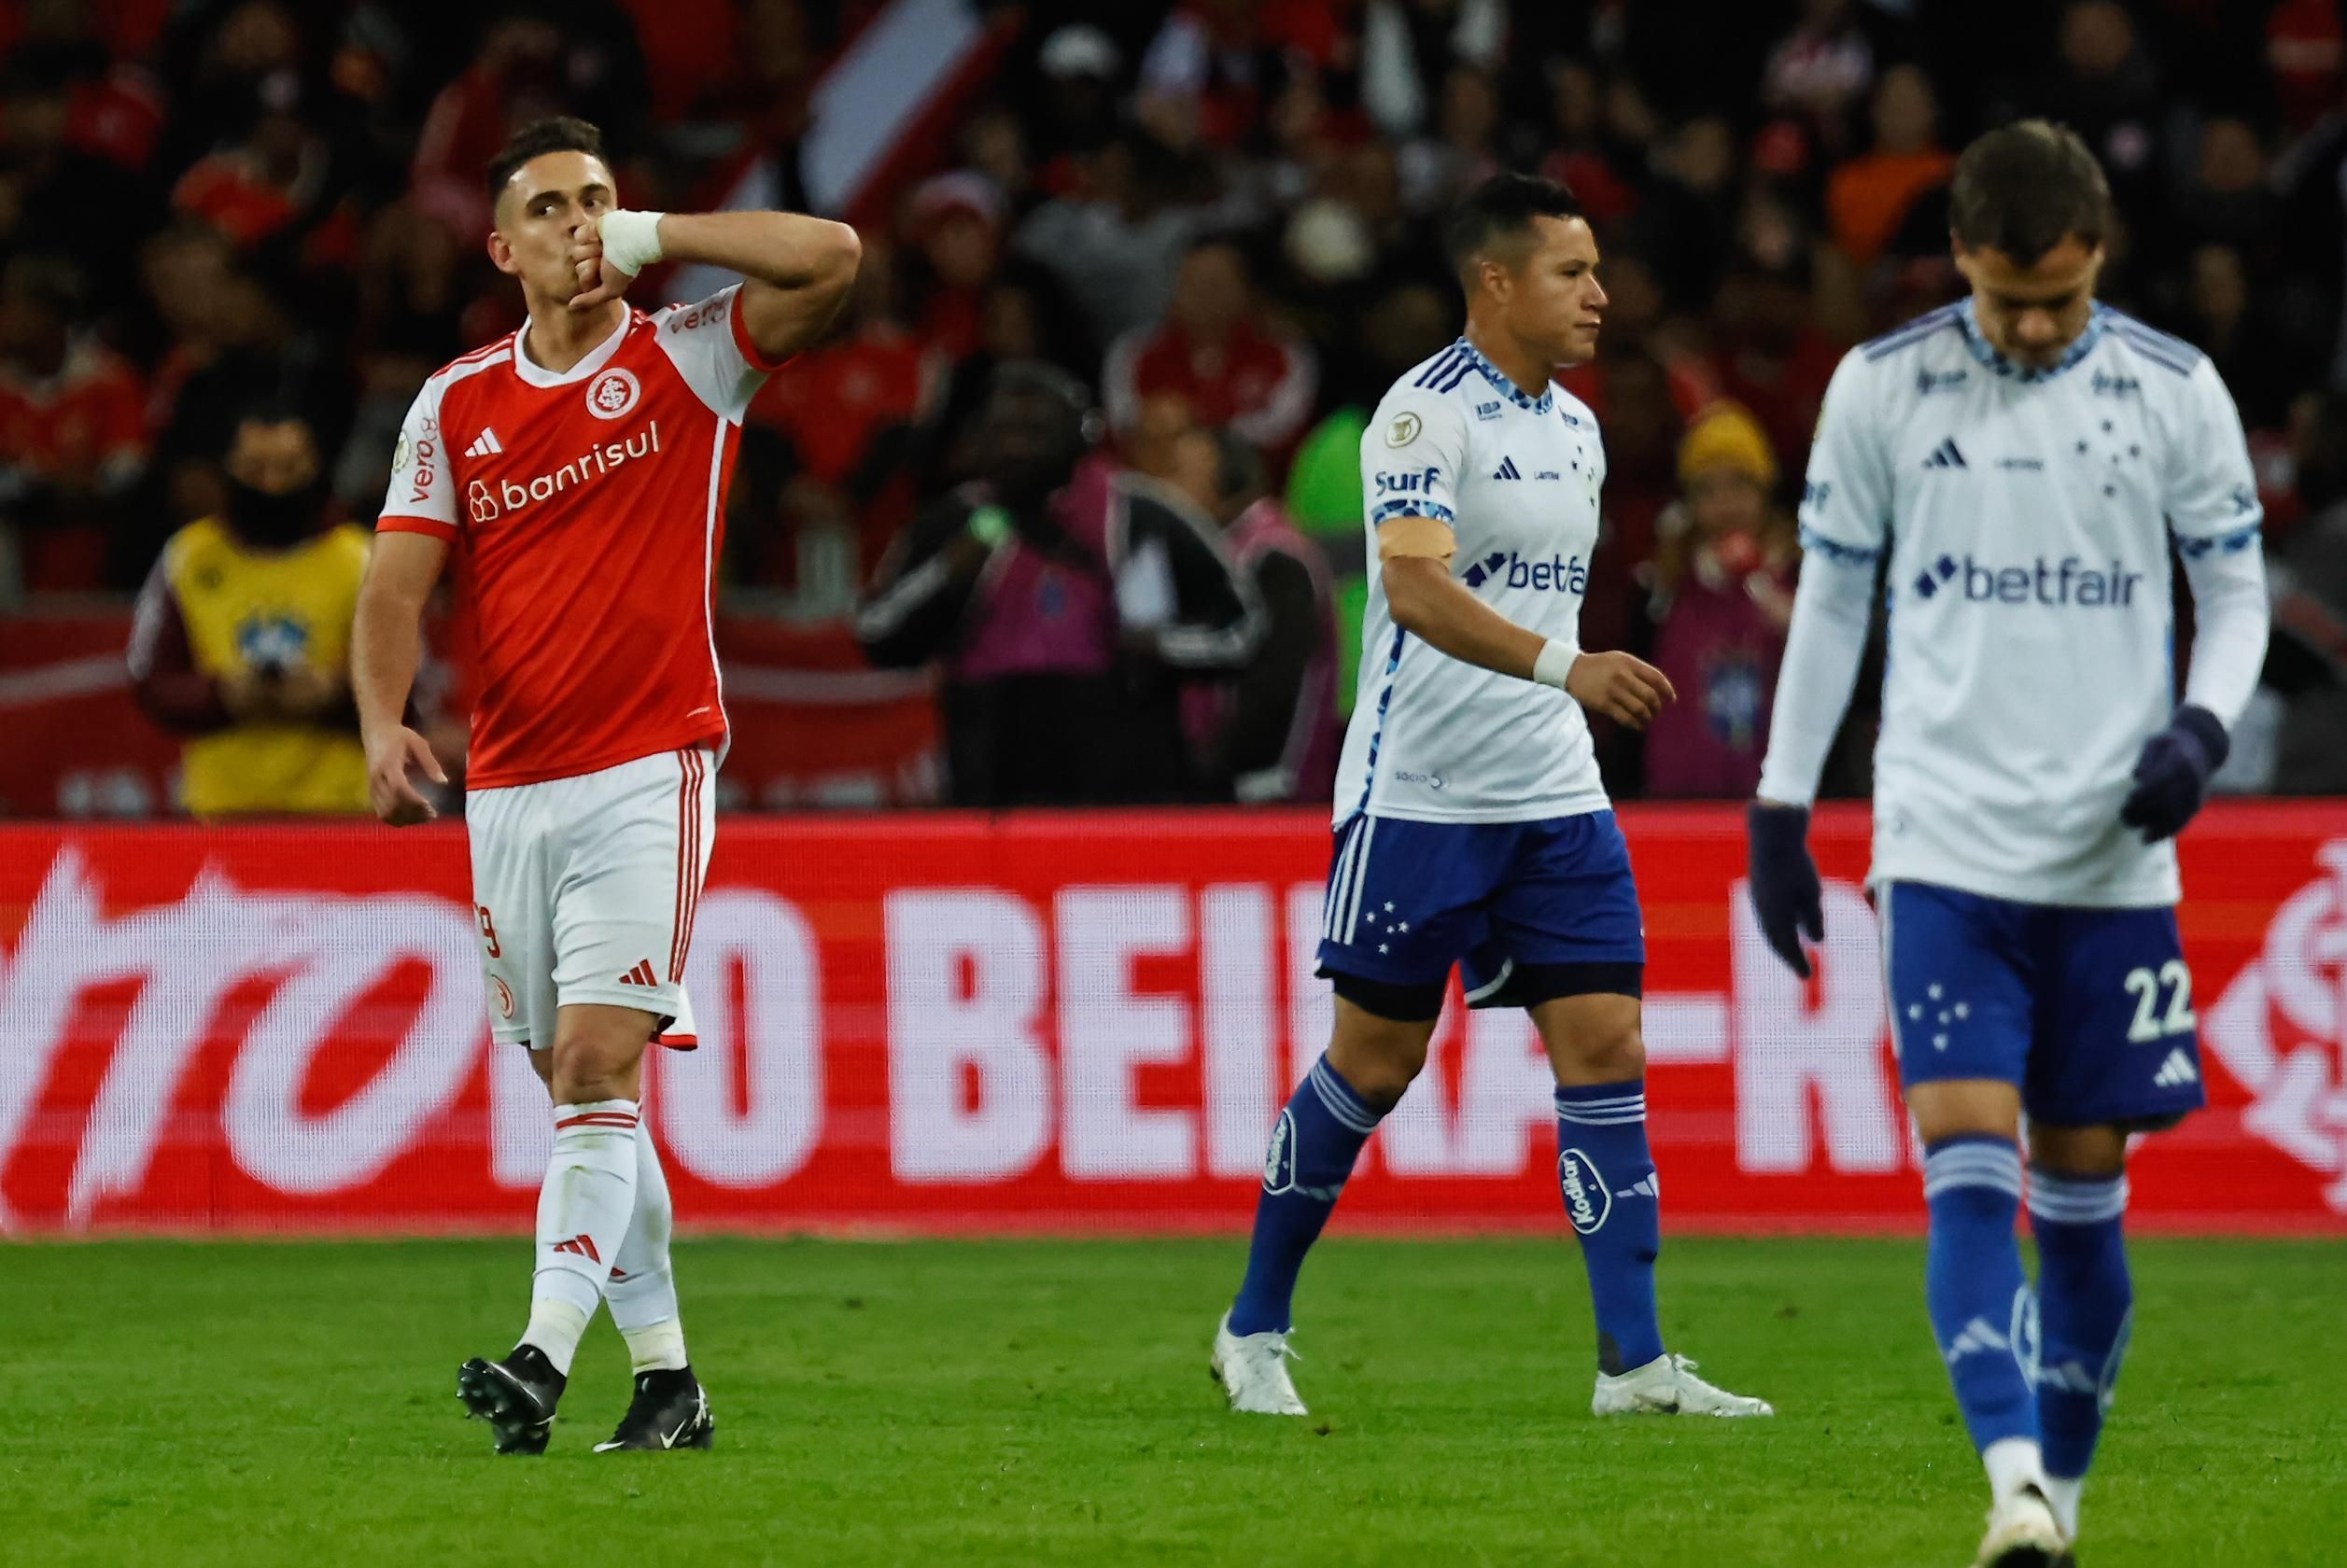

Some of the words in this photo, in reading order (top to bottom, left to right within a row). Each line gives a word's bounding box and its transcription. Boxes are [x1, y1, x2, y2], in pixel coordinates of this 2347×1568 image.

[409, 440, 435, 504] vero
[500, 420, 659, 511] banrisul
[1375, 467, 1441, 497] Surf
[1963, 554, 2143, 607] betfair
[473, 902, 500, 959] 9
[2124, 959, 2198, 1043] 22
